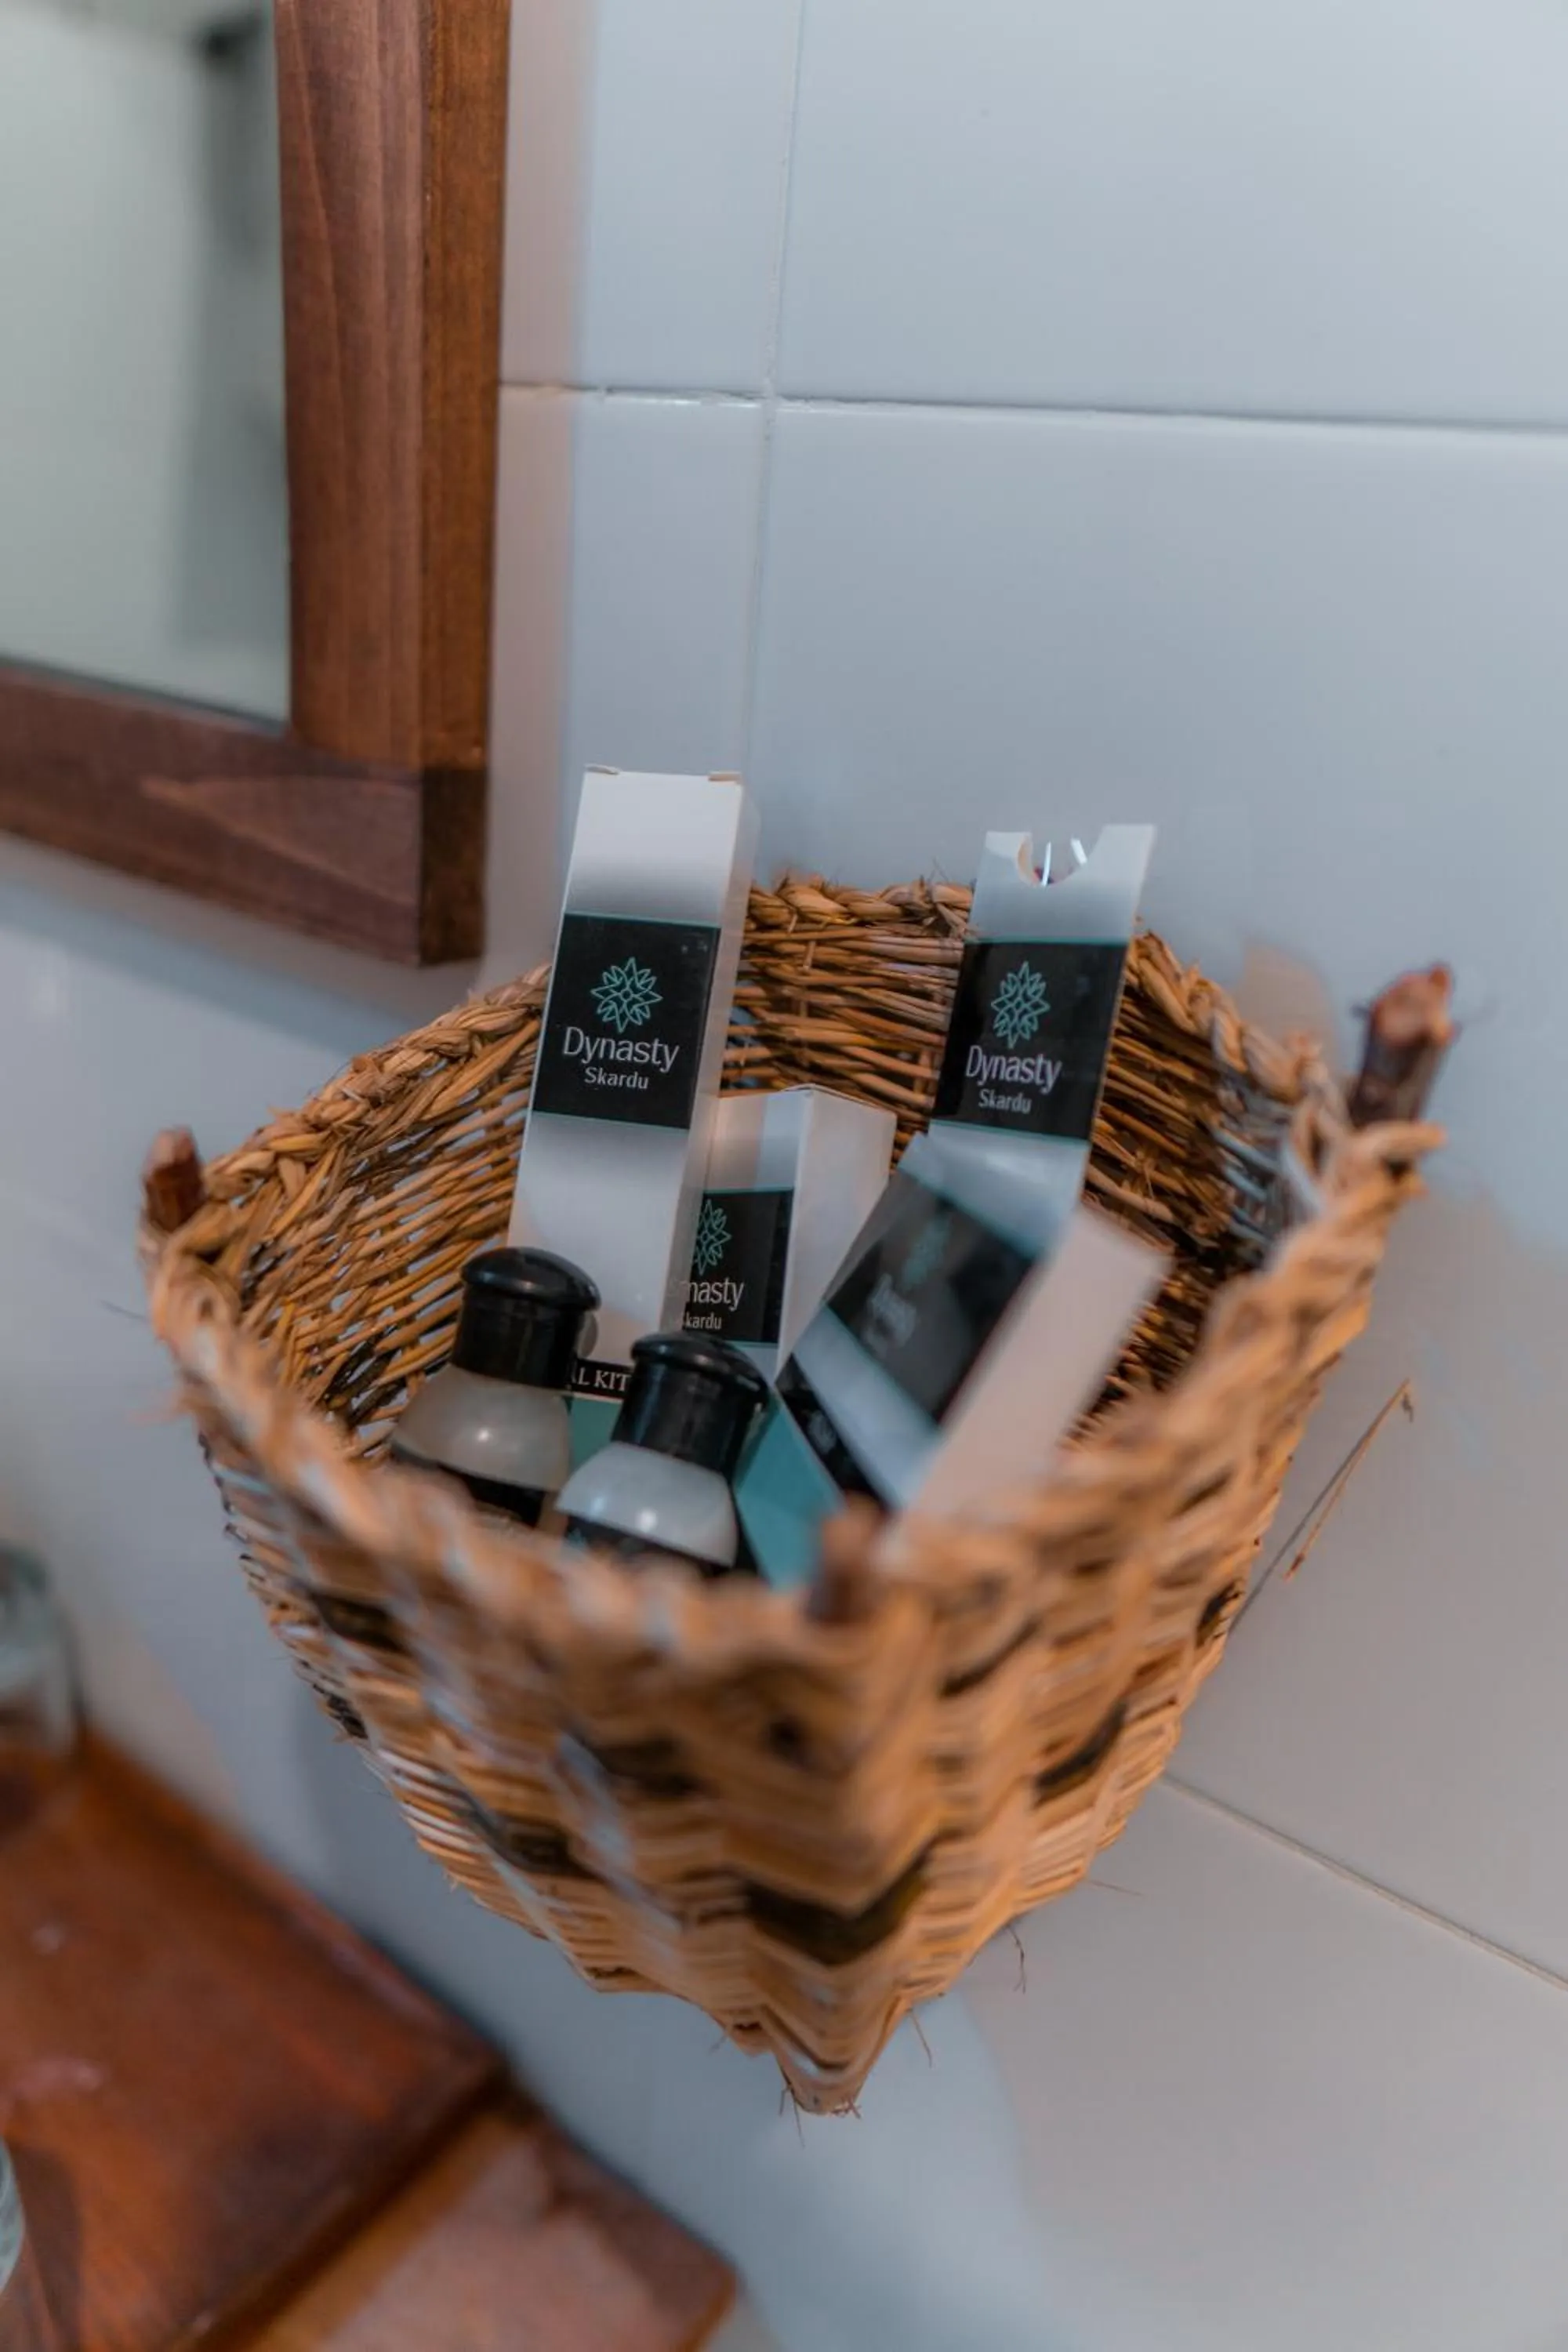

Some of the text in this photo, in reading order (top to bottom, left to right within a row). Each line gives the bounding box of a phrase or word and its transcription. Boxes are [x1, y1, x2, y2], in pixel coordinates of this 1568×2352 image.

[562, 1025, 680, 1073] Dynasty
[583, 1065, 650, 1091] Skardu
[965, 1044, 1062, 1094] Dynasty
[978, 1087, 1033, 1115] Skardu
[688, 1276, 745, 1312] nasty
[684, 1311, 722, 1330] kardu
[593, 1369, 632, 1392] KIT
